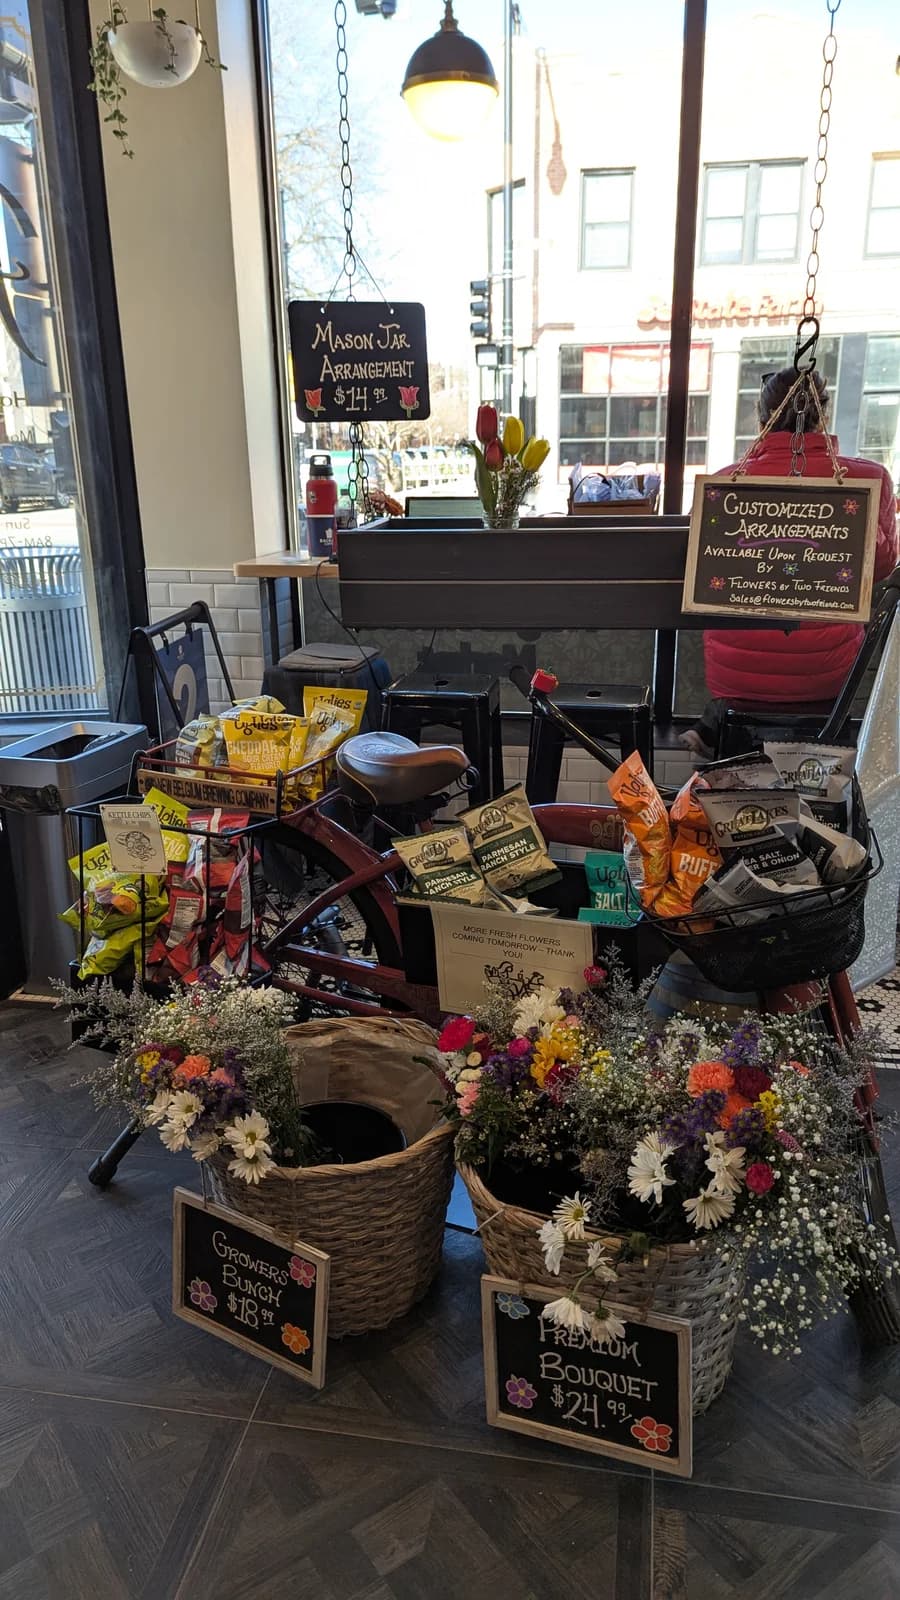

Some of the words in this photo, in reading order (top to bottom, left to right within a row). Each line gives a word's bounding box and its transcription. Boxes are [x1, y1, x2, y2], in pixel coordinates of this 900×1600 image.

[312, 321, 373, 352] MASON
[377, 323, 411, 350] JAR
[320, 355, 415, 382] ARRANGEMENT
[724, 492, 834, 519] CUSTOMIZED
[724, 519, 849, 540] ARRANGEMENTS
[704, 545, 765, 559] AVAILABLE
[768, 547, 795, 561] UPON
[803, 548, 852, 562] REQUEST
[757, 562, 773, 573] BY
[728, 576, 776, 590] FLOWERS
[813, 580, 850, 593] FRIENDS
[202, 784, 235, 804] BREWING
[235, 789, 270, 809] COMPANY
[480, 854, 508, 872] RANCH
[509, 843, 537, 859] STYLE
[482, 838, 527, 863] PARMESAN
[771, 852, 800, 866] ONION
[424, 871, 467, 889] PARMESAN
[594, 891, 624, 911] SALT
[452, 932, 484, 943] COMING
[488, 938, 537, 952] TOMORROW
[547, 948, 574, 958] THANK
[463, 925, 488, 935] MORE
[490, 929, 517, 939] FRESH
[520, 933, 560, 946] FLOWERS
[212, 1231, 289, 1286] GROWERS
[222, 1264, 282, 1307] BUNCH
[539, 1352, 659, 1401] BOUQUET
